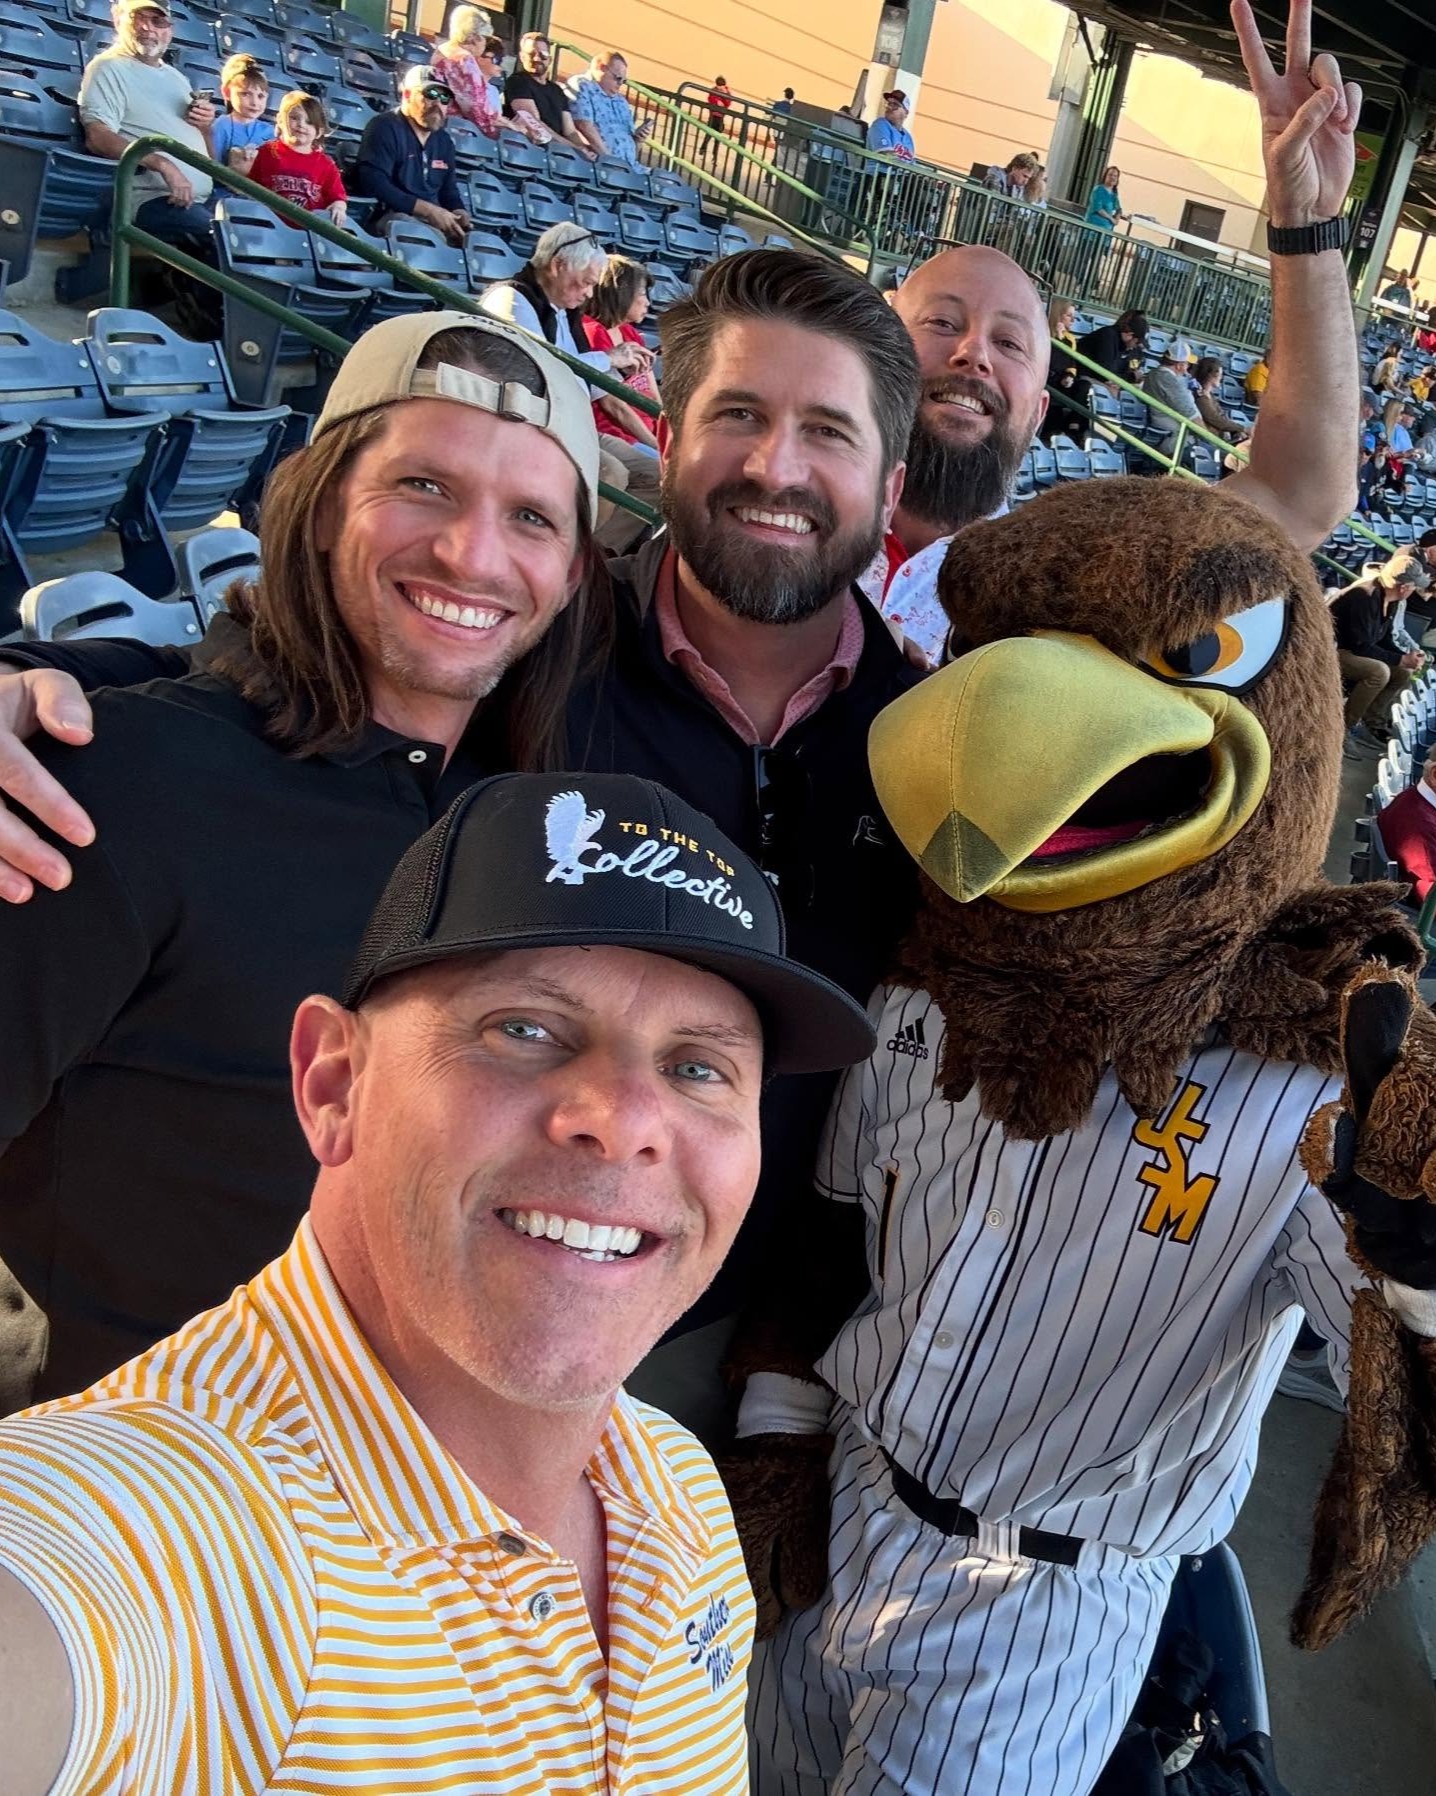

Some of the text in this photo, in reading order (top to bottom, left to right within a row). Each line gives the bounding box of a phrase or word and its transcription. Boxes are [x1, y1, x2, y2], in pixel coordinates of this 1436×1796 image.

[1360, 227, 1376, 239] 107
[618, 821, 736, 877] TO THE TOP
[574, 839, 754, 930] Collective
[886, 1036, 930, 1060] adidas
